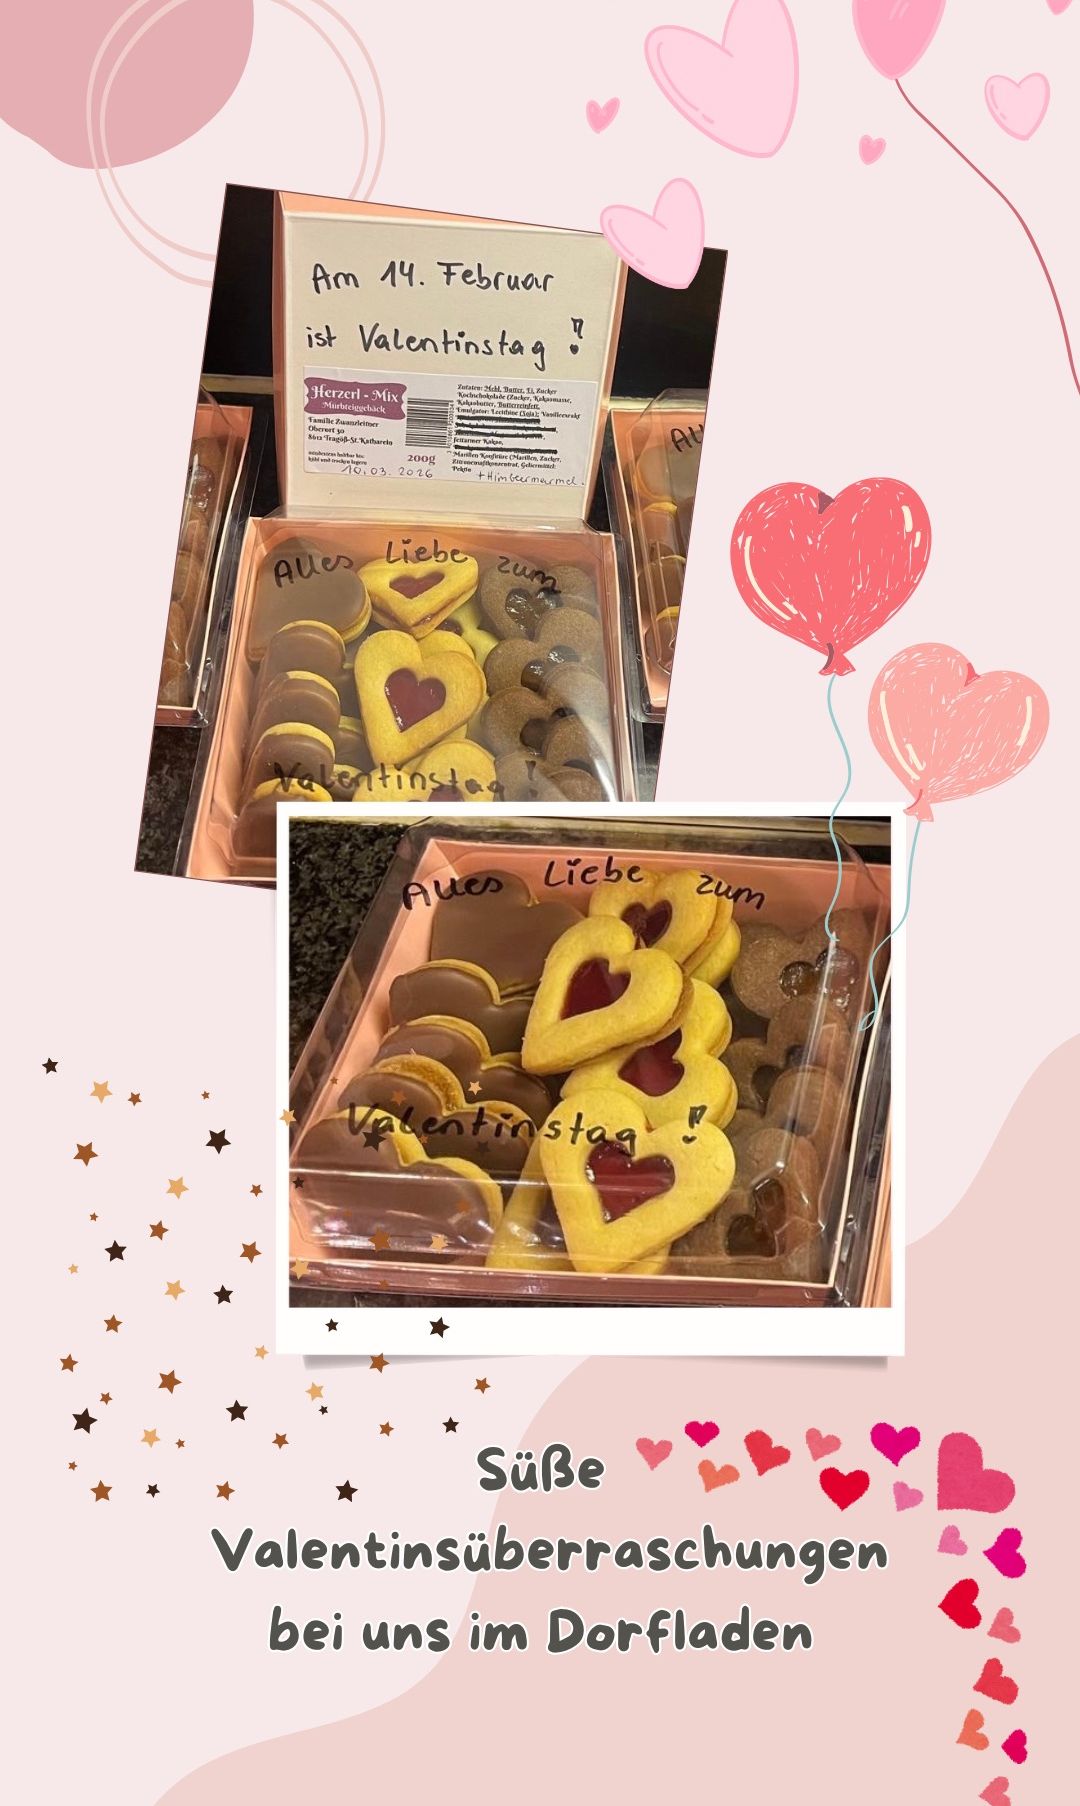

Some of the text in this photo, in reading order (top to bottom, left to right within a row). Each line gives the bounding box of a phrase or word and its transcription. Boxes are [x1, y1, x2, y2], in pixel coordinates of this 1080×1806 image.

[312, 261, 554, 294] Am 14. Februar
[306, 325, 337, 348] ist
[359, 323, 546, 371] Valentinstag
[310, 384, 360, 400] Herzerl
[371, 388, 399, 403] Mix
[308, 417, 334, 425] Familie
[308, 425, 335, 434] Oberort
[407, 455, 436, 466] 200g
[274, 539, 561, 593] Alles Liebe zum
[275, 762, 504, 802] Valentinstag
[402, 856, 765, 910] Alles Liebe zum
[348, 1103, 636, 1157] Valentinstag
